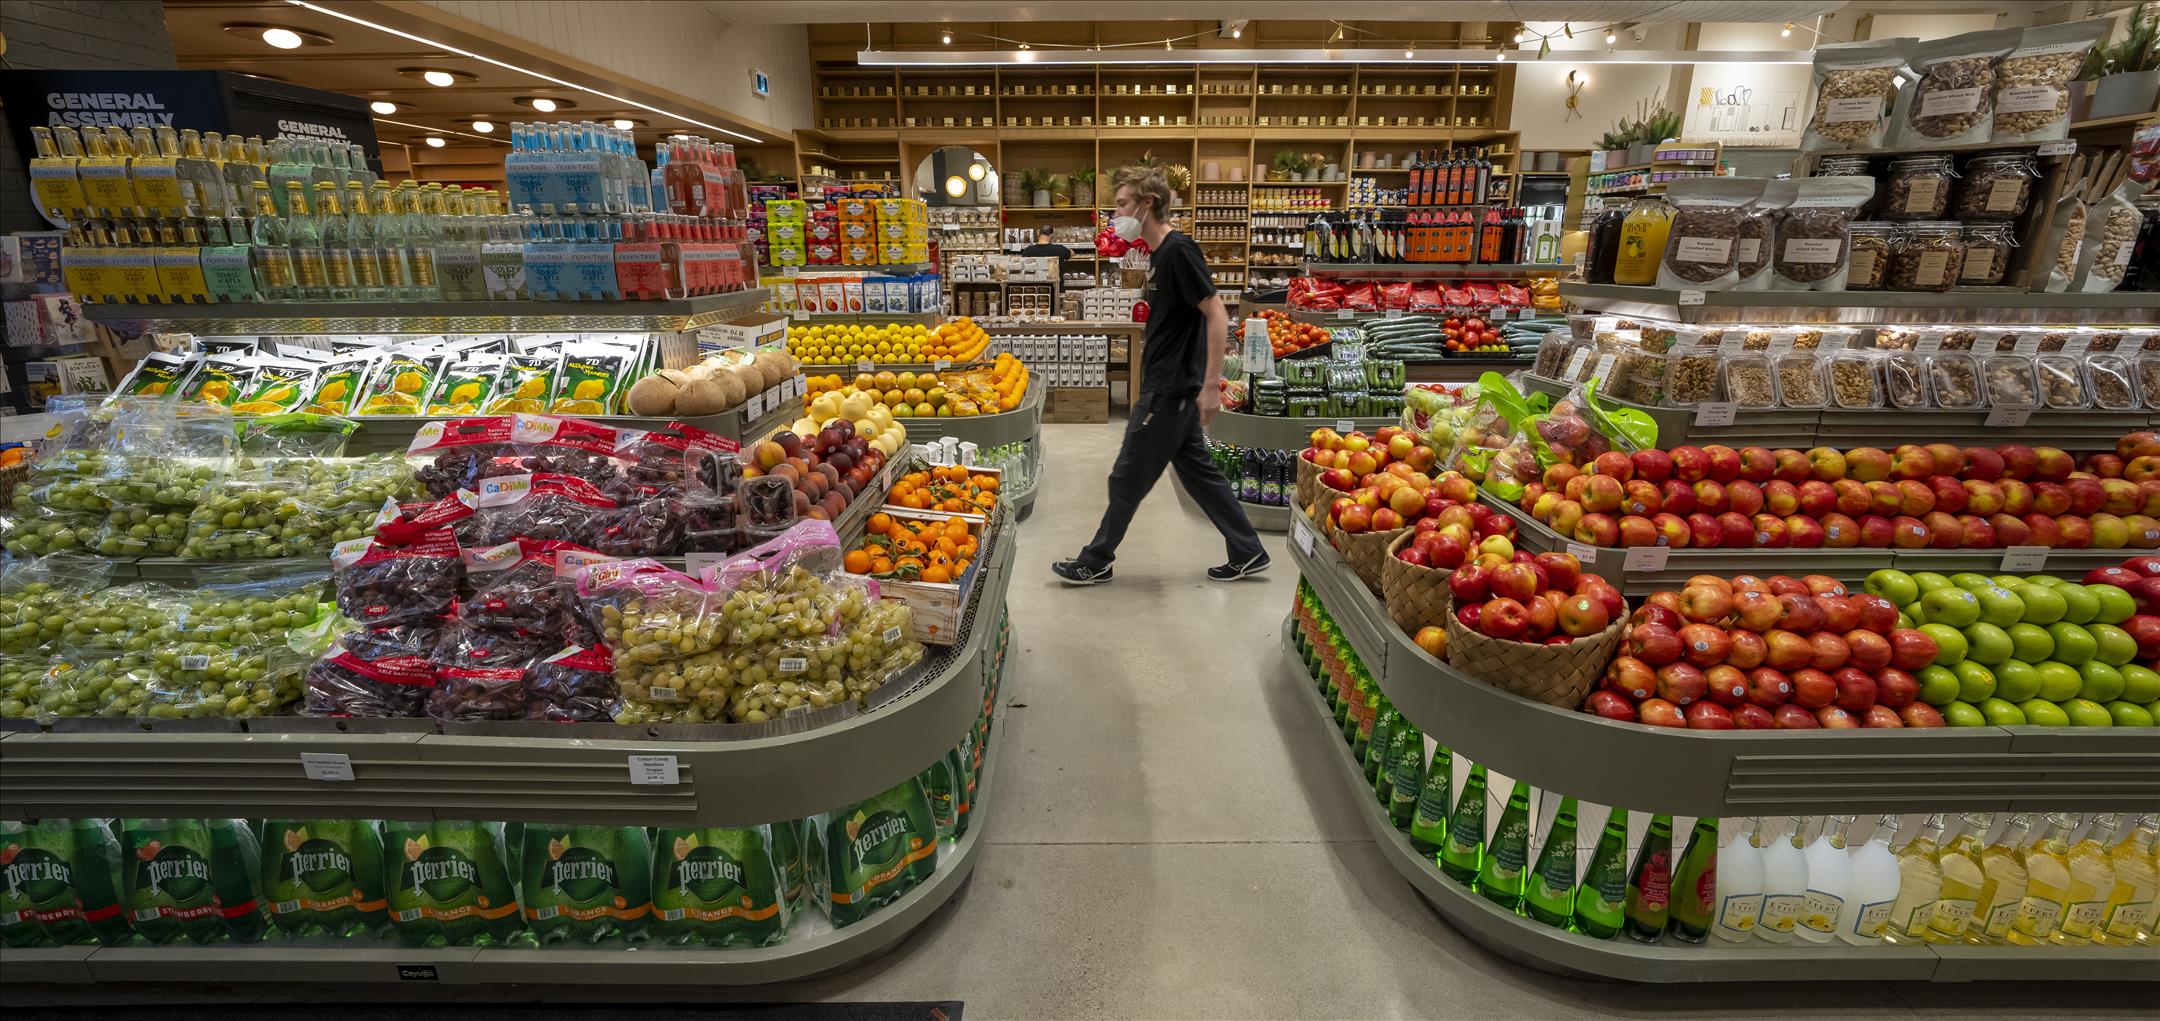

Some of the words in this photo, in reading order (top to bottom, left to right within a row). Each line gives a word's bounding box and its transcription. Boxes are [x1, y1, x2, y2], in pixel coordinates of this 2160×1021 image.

[47, 93, 165, 110] GENERAL
[48, 111, 174, 128] ASSEMBLY
[278, 120, 347, 139] GENERAL
[528, 359, 543, 367] 7D
[585, 358, 600, 366] 7D
[486, 481, 529, 495] CaDiMe
[853, 814, 907, 875] perrier
[3, 856, 71, 901] perrier
[146, 854, 208, 898] perrier
[289, 847, 351, 888] perrier
[410, 854, 476, 897] perrier
[551, 856, 613, 896] perrier
[676, 855, 742, 896] perrier
